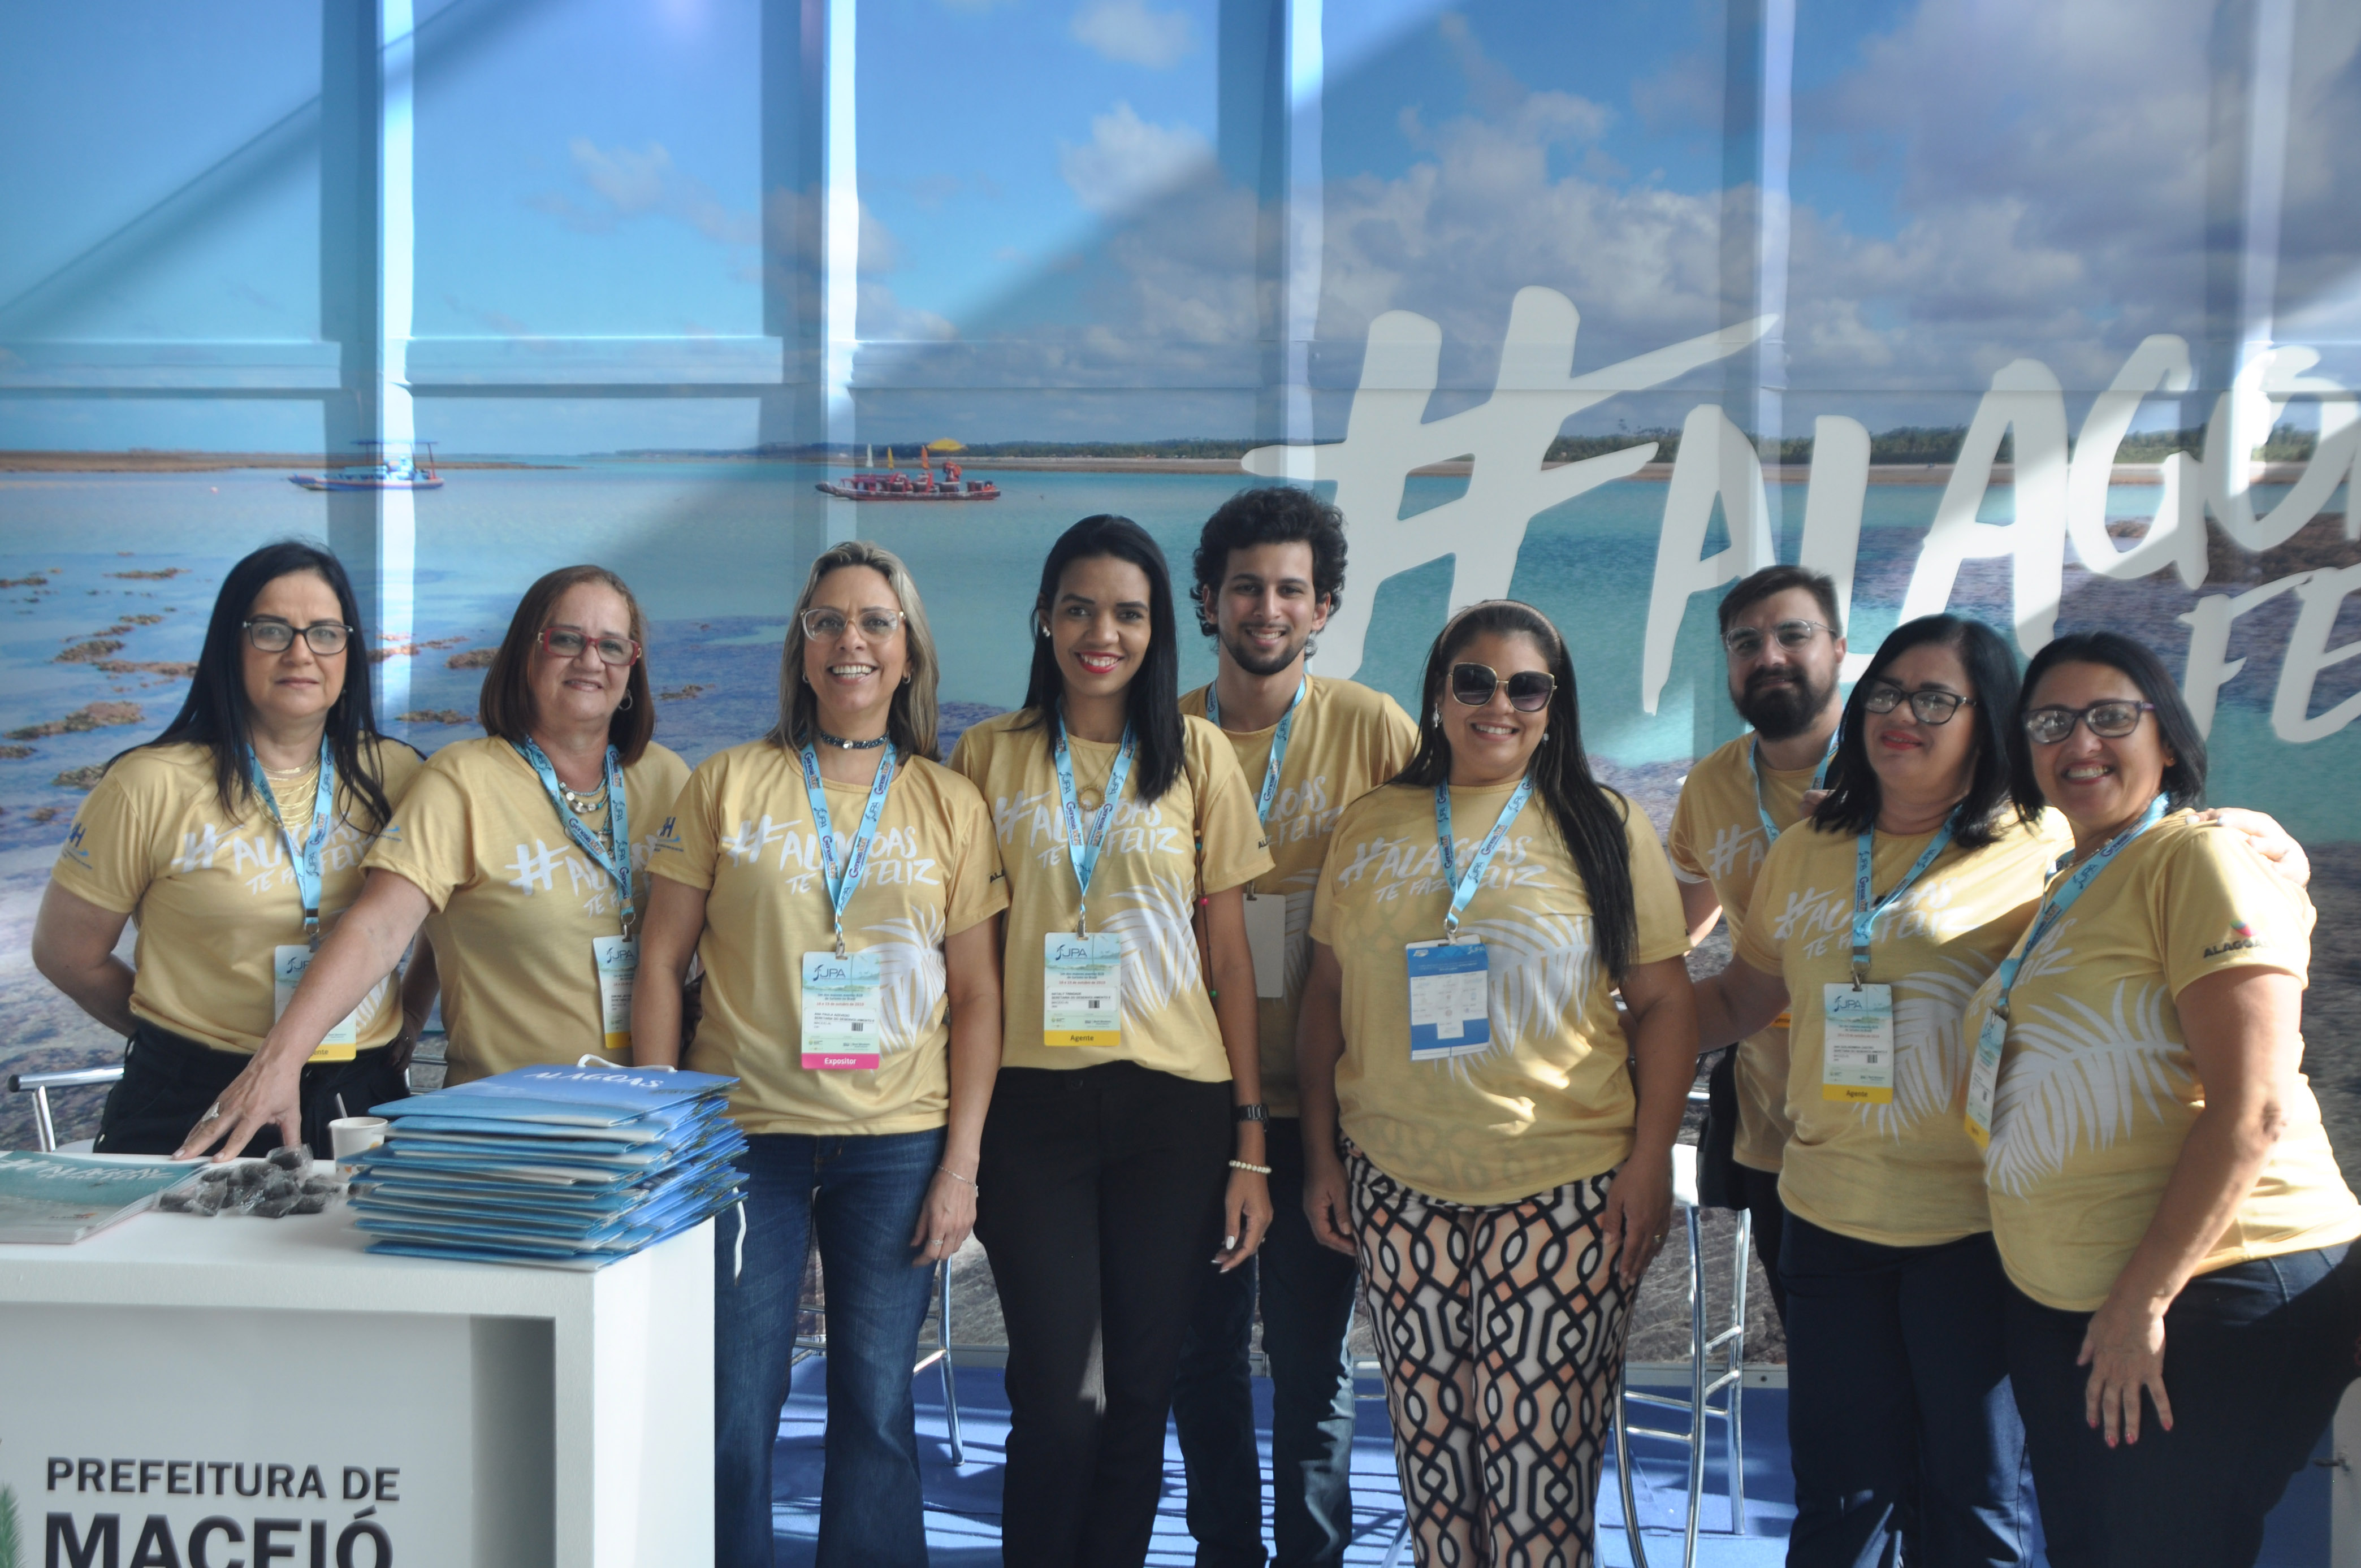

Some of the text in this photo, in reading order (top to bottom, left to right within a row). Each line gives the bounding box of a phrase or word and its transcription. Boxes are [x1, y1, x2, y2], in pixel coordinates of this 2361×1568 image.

[1242, 285, 2361, 717] #ALAGO
[804, 751, 815, 776] Genesis
[874, 771, 888, 795] Genesis
[881, 763, 890, 776] Tours
[1263, 773, 1275, 802] Genesis
[569, 817, 593, 843] Genesis
[1066, 801, 1077, 830] Genesis
[1072, 829, 1080, 846] Tours
[1099, 803, 1113, 831] Genesis
[823, 835, 834, 862] Genesis
[1037, 844, 1066, 869] TE
[1106, 826, 1185, 857] FELIZ
[1481, 833, 1498, 855] Genesis
[849, 851, 863, 878] Genesis
[858, 838, 867, 853] Tours
[245, 869, 276, 895] TE
[785, 872, 818, 895] TE
[862, 858, 941, 889] FELIZ
[1858, 876, 1869, 901] Genesis
[583, 891, 605, 918] TE
[1374, 880, 1407, 903] TE
[612, 949, 634, 960] JPA
[1062, 948, 1088, 957] JPA
[1802, 933, 1834, 960] TE
[820, 968, 846, 978] JPA
[1840, 999, 1862, 1009] JPA
[824, 1058, 857, 1067] Expositor
[523, 1072, 664, 1088] ALAGOAS
[1846, 1089, 1869, 1098] Agente
[47, 1456, 400, 1501] PREFEITURA DE
[45, 1505, 394, 1568] MACEIÓ
